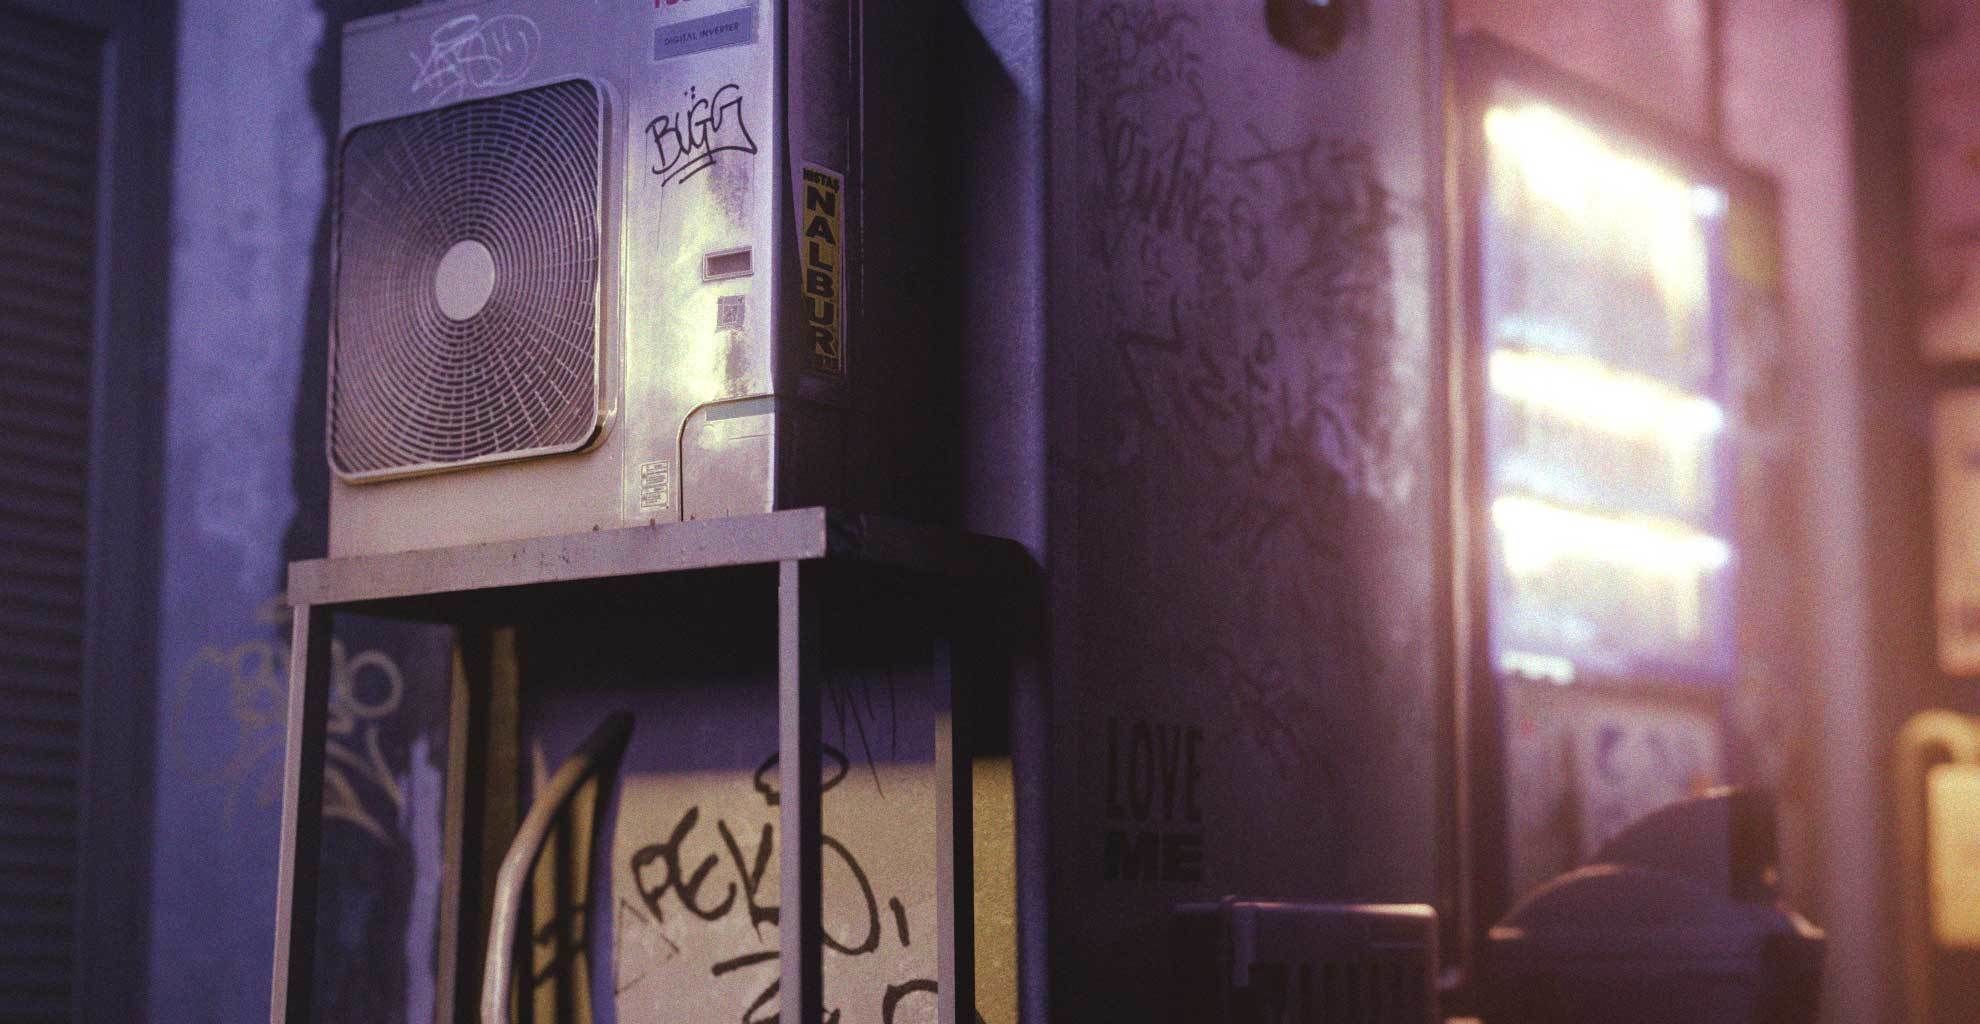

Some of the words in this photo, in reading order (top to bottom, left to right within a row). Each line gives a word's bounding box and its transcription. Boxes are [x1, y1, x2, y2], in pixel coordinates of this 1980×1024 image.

[664, 32, 697, 46] DIGITAL
[699, 22, 739, 39] INVERTER
[805, 186, 837, 357] NALBUR
[1104, 718, 1201, 822] LOVE
[1104, 832, 1201, 881] ME
